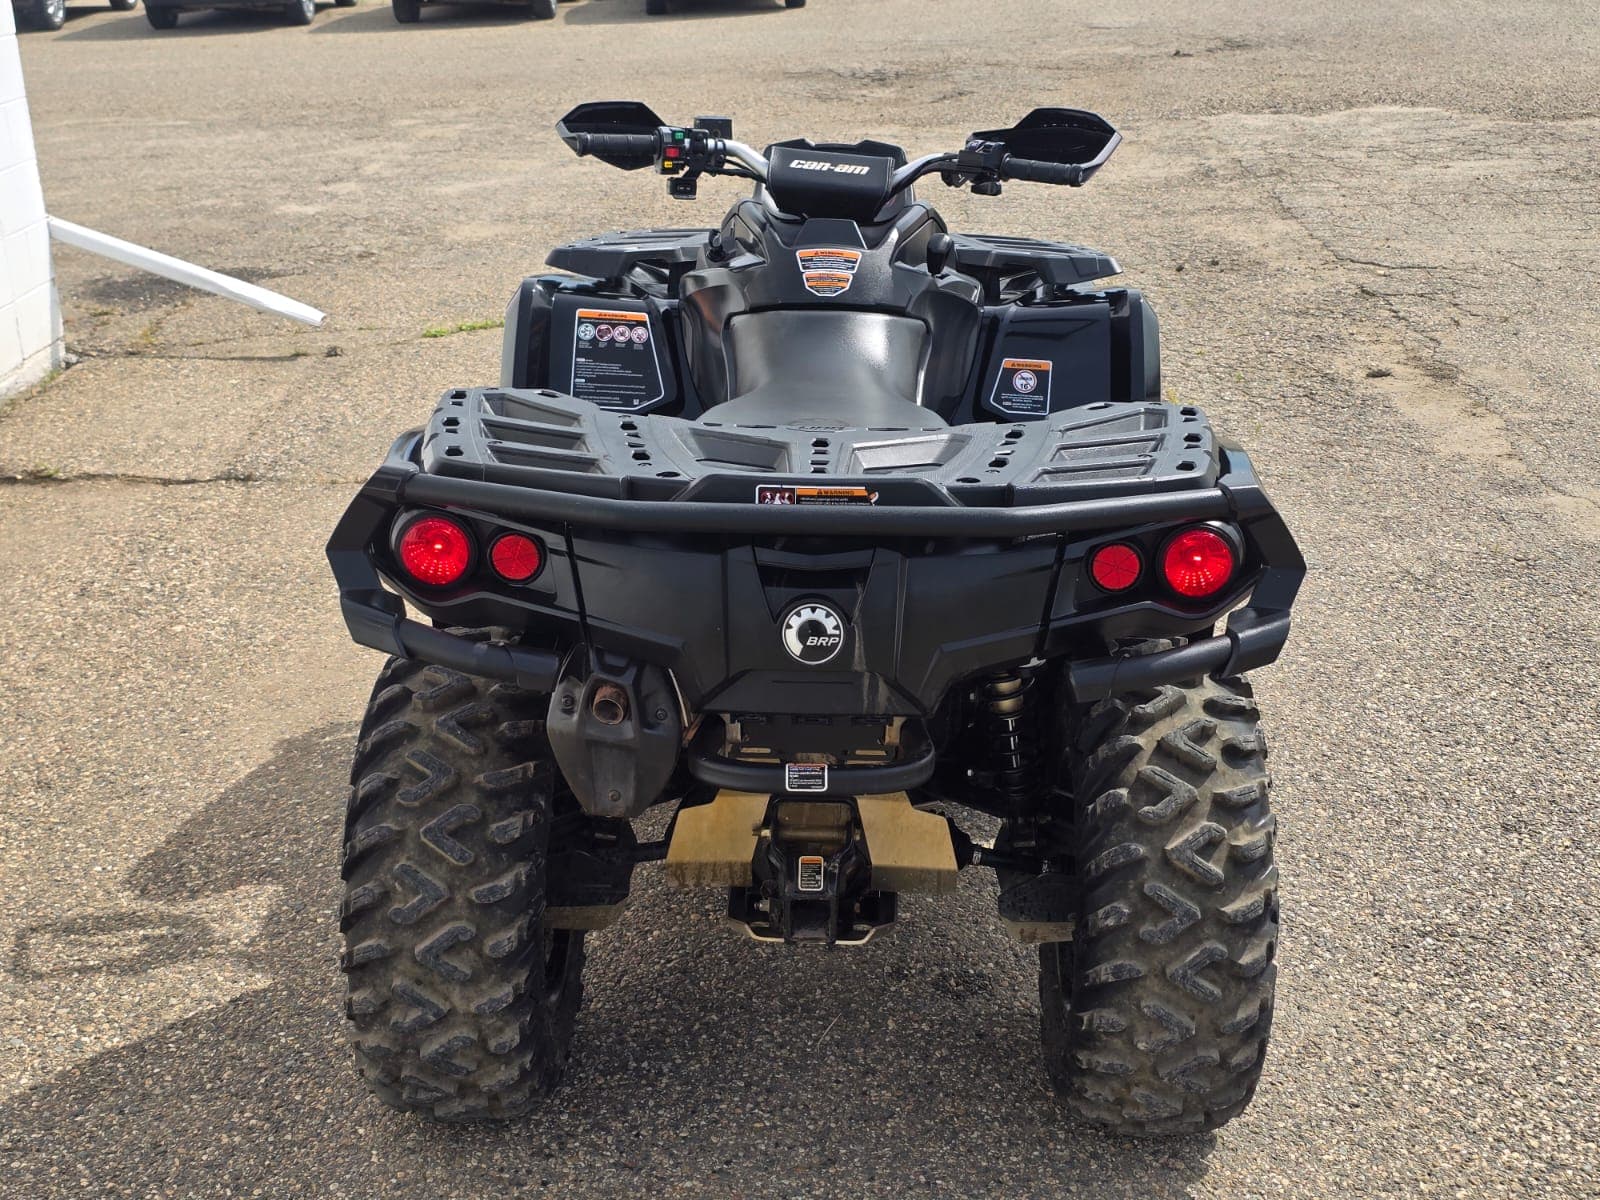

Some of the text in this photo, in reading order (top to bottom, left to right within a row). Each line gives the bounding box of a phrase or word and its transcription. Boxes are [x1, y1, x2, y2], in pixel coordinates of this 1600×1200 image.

[789, 159, 871, 175] can-am
[824, 488, 856, 496] WARNING
[806, 636, 840, 647] BRP
